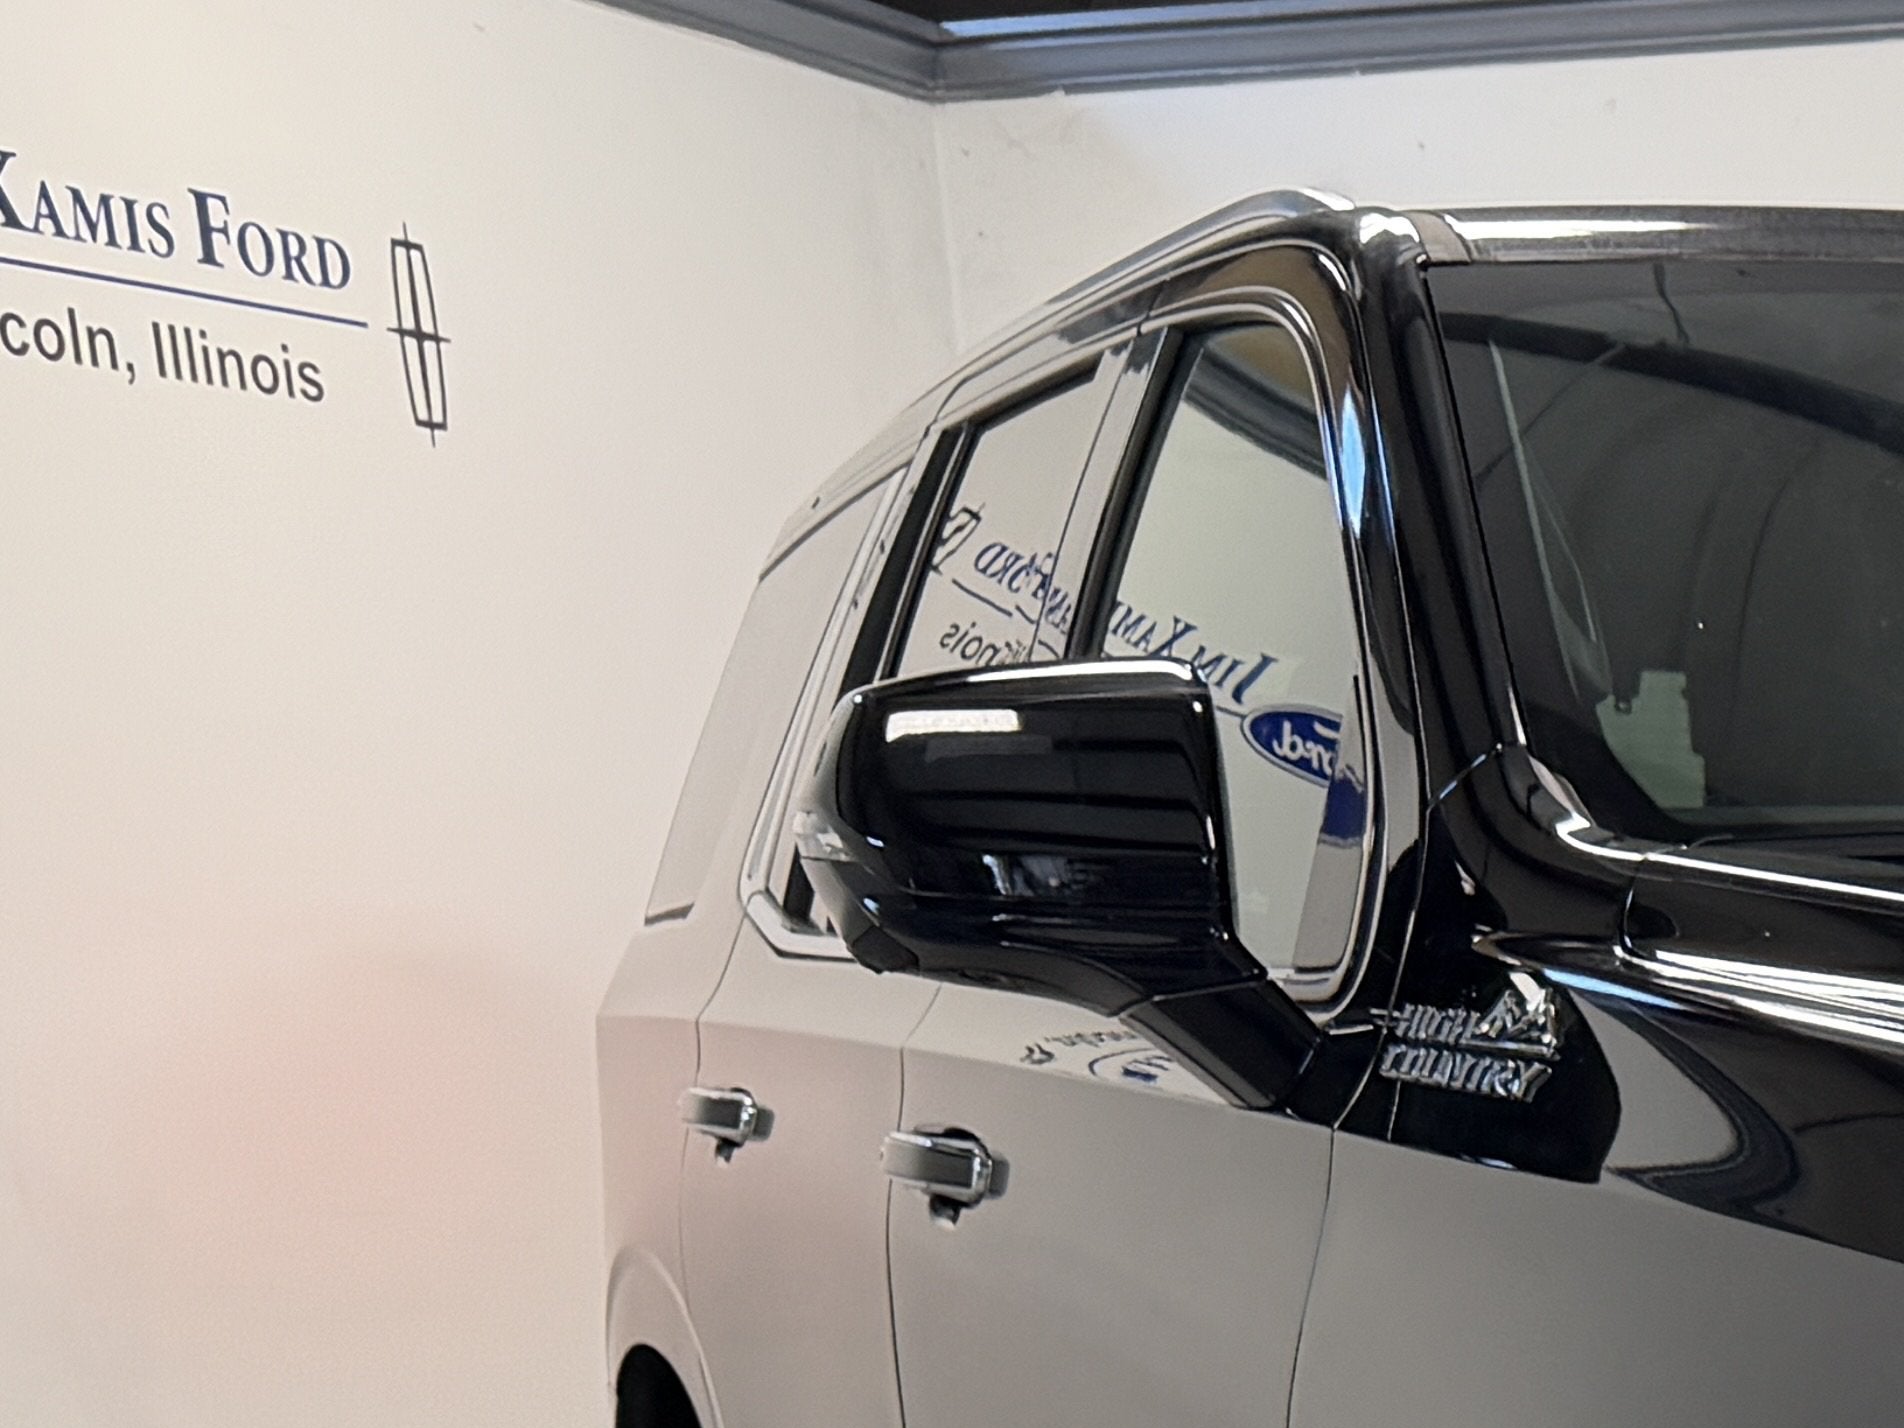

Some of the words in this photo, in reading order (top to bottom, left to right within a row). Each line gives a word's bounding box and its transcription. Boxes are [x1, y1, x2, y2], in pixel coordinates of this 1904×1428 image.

[187, 187, 351, 290] FORD
[152, 320, 325, 403] Illinois
[1379, 1044, 1553, 1103] COUNTRY
